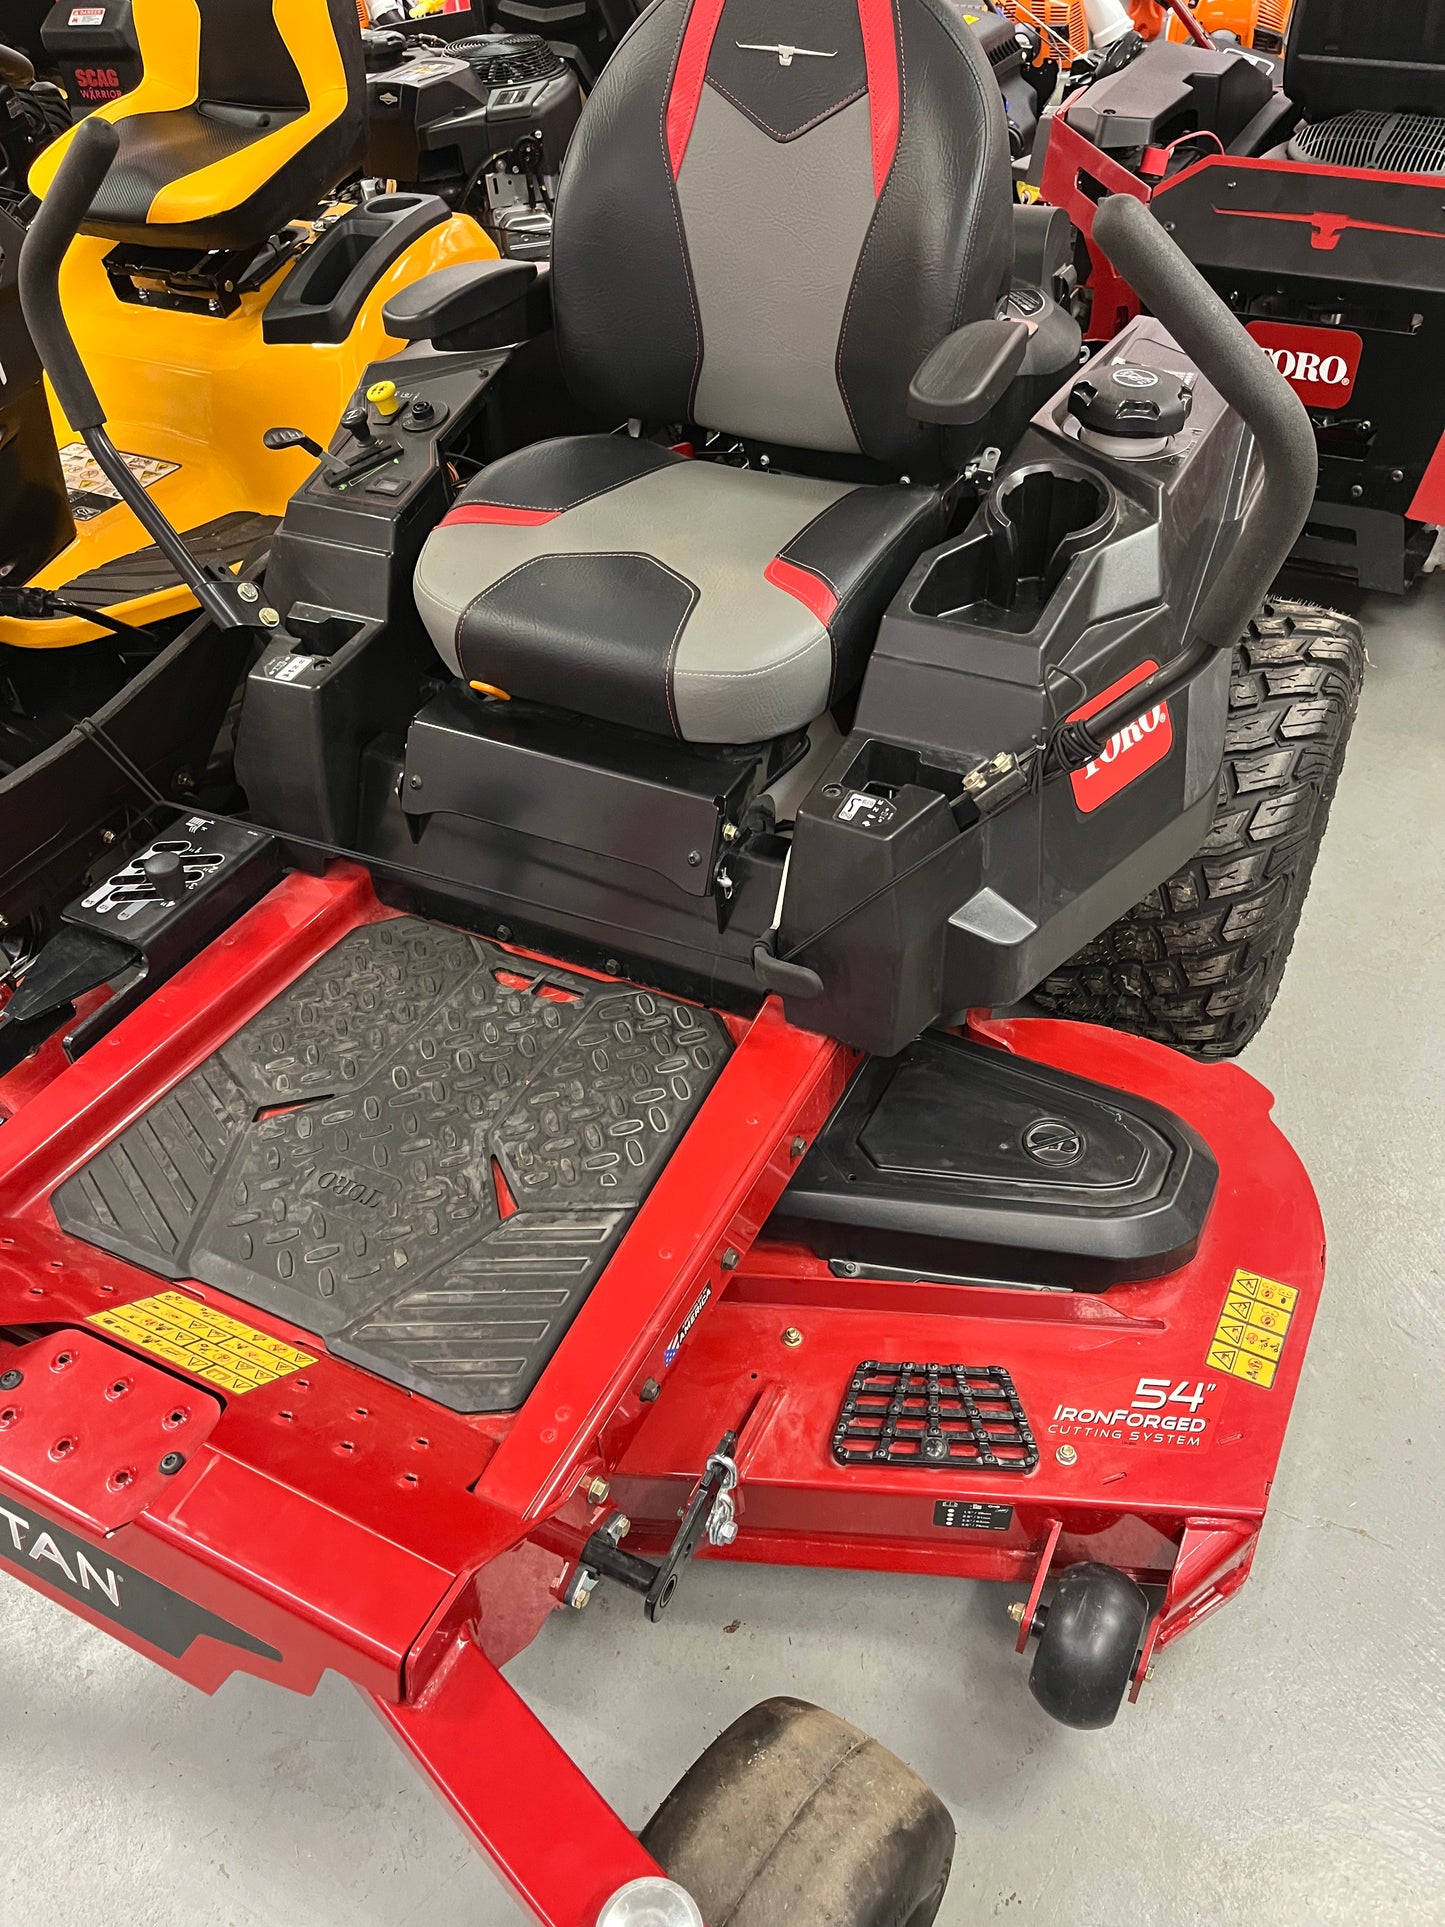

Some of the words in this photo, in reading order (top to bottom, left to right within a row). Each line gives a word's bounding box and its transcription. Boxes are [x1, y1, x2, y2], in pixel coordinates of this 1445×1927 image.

[75, 69, 119, 87] SCAG
[80, 87, 122, 100] WARRIOR
[318, 1172, 384, 1208] TORO
[679, 1288, 712, 1343] AMERICA
[1131, 1378, 1217, 1413] 54"
[1048, 1424, 1123, 1440] CUTTING
[1129, 1431, 1200, 1447] SYSTEM
